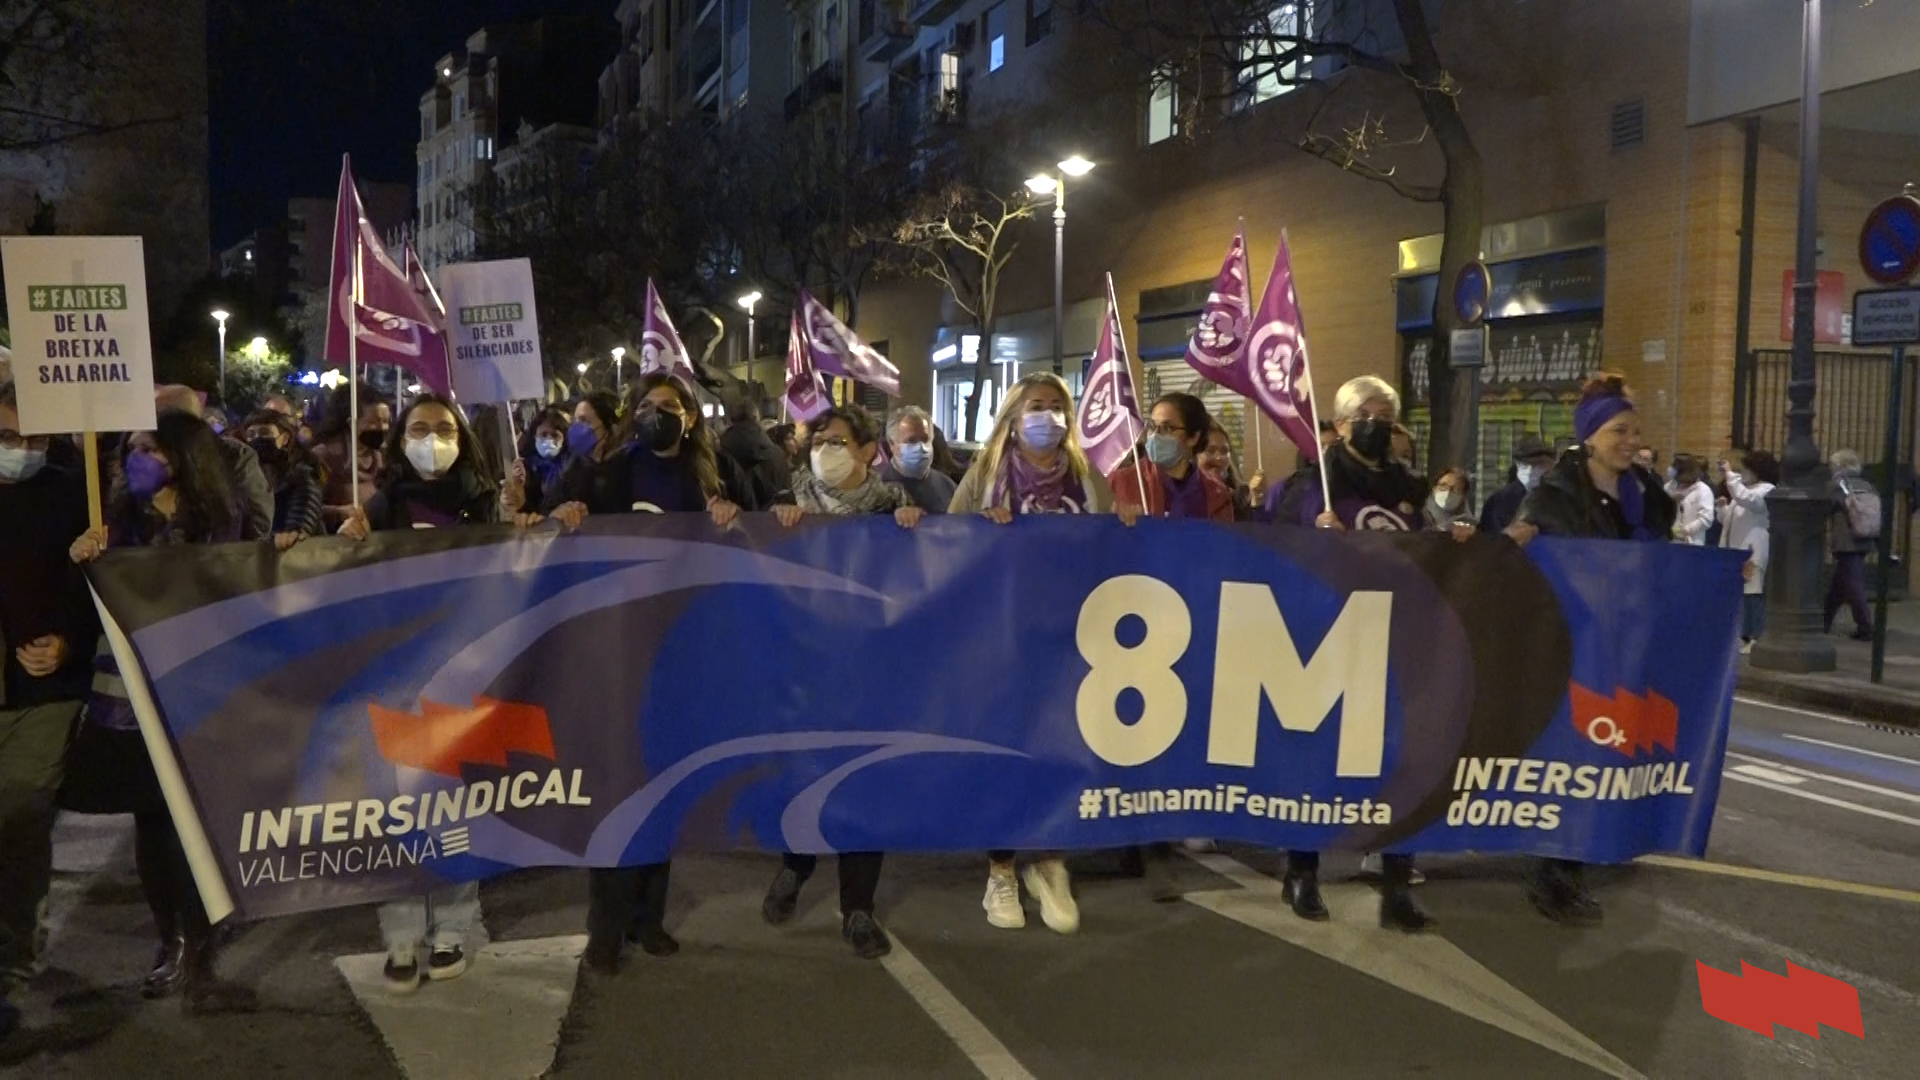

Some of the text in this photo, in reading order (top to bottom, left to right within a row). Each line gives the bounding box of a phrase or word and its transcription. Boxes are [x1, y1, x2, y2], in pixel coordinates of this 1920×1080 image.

[33, 287, 122, 308] #FARTES
[54, 313, 107, 333] DE LA
[472, 323, 514, 340] DE SER
[45, 338, 120, 358] BRETXA
[456, 339, 534, 360] SILENCIADES
[38, 363, 131, 384] SALARIAL
[1075, 573, 1393, 778] 8M
[1452, 757, 1694, 800] INTERSINDICAL
[239, 768, 592, 853] INTERSINDICAL
[1079, 784, 1392, 824] #TsunamiFeminista
[1446, 791, 1562, 830] dones
[238, 836, 437, 887] VALENCIANA
